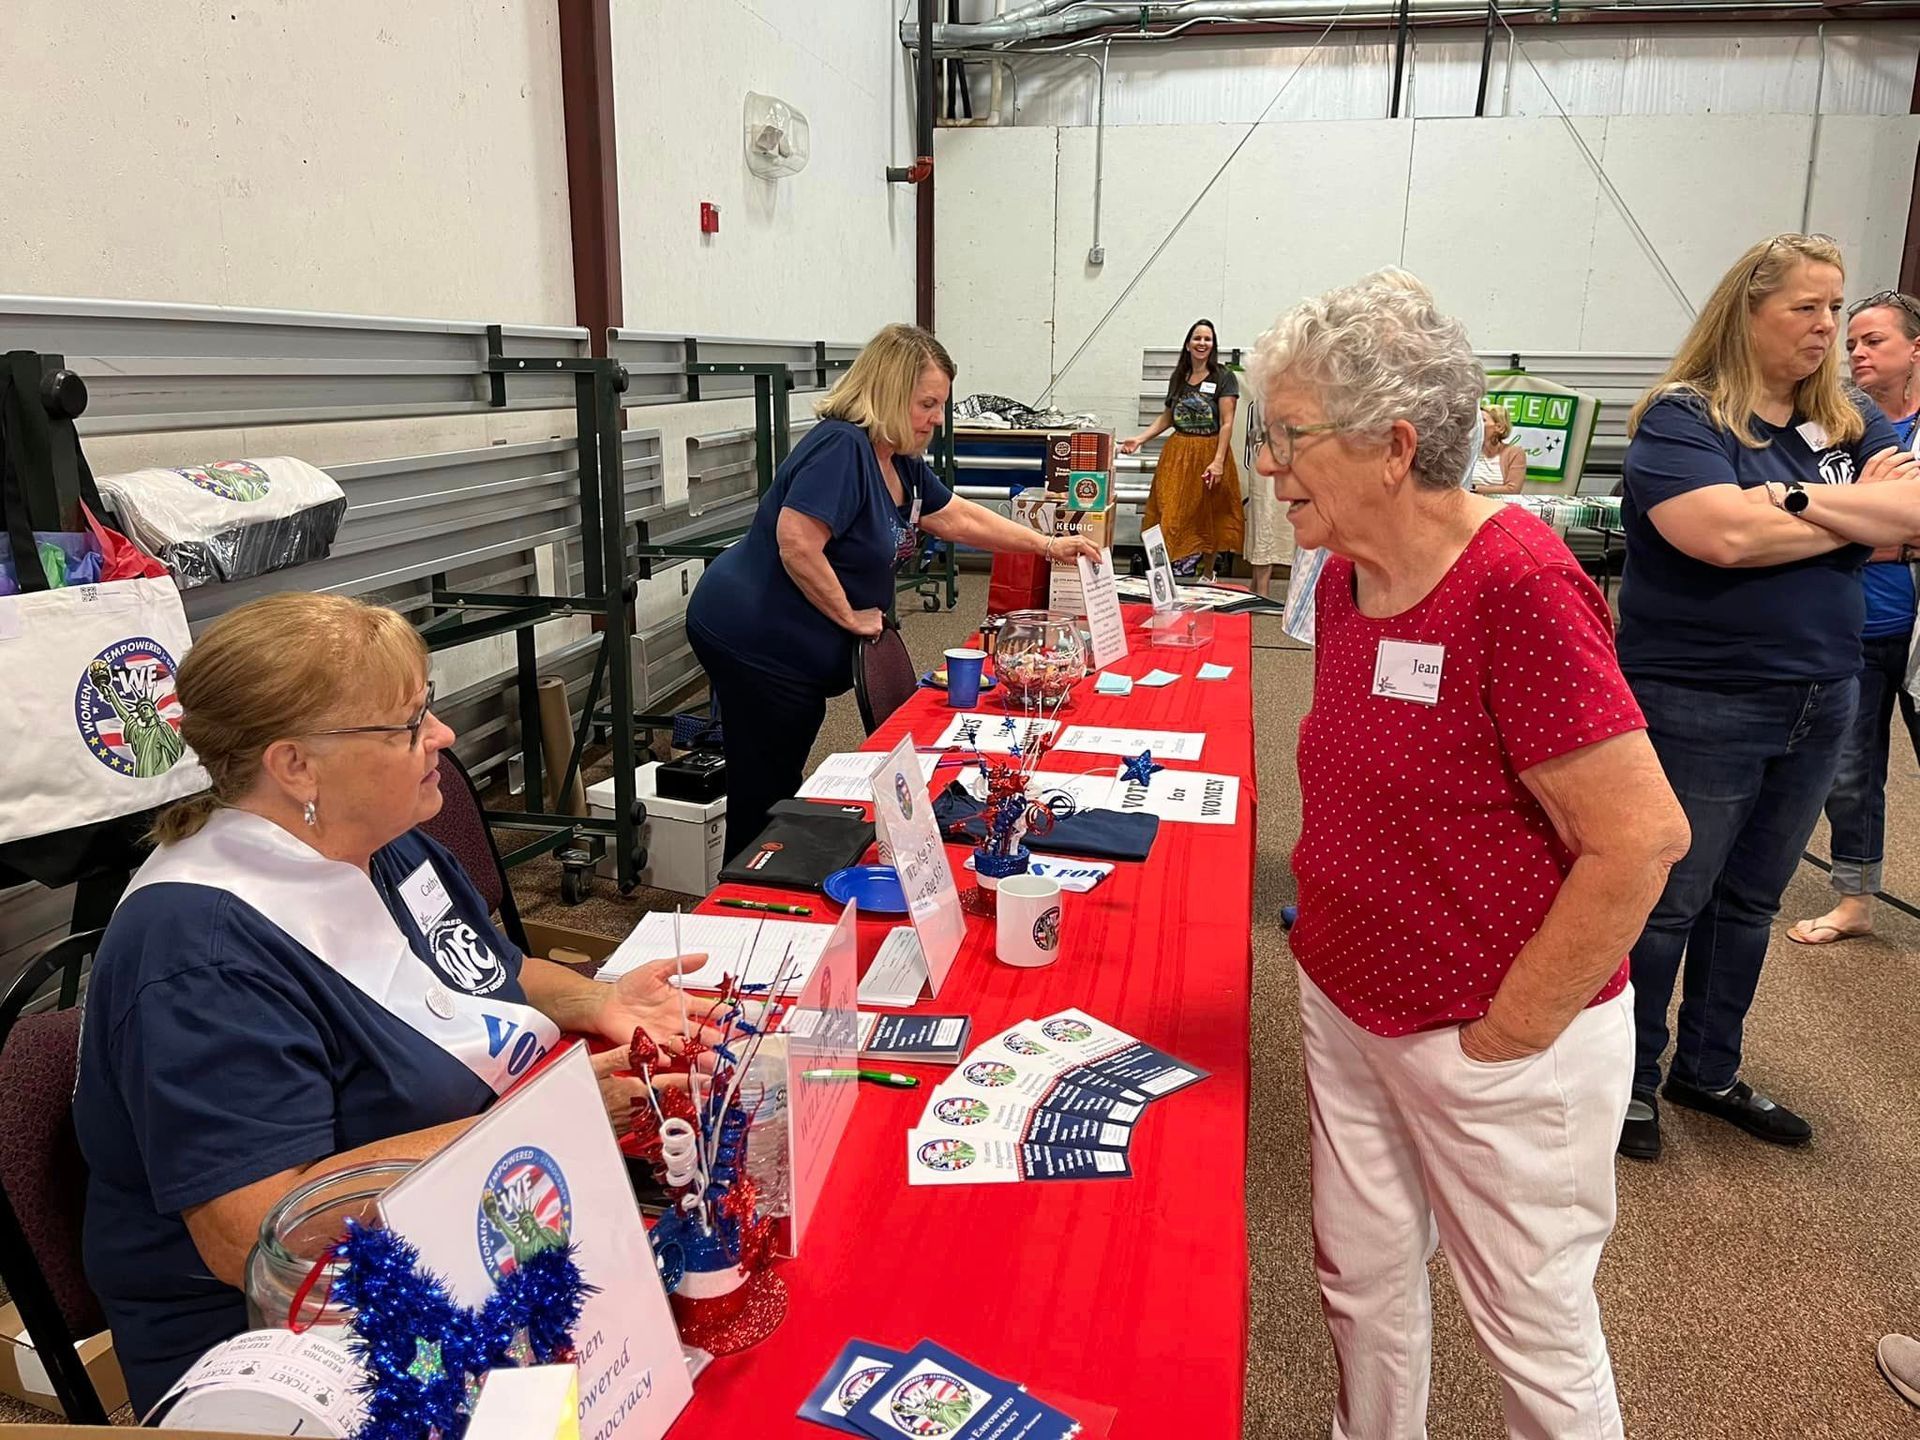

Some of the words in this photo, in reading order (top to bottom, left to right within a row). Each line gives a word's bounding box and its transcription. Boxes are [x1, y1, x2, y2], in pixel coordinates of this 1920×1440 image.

[1056, 522, 1094, 531] KEURIG
[1410, 659, 1439, 675] Jean
[81, 684, 92, 734] WOMEN
[104, 641, 162, 663] EMPOWERED
[118, 665, 158, 694] WE
[1166, 788, 1186, 802] for
[1200, 779, 1224, 816] WOMEN
[420, 876, 442, 897] Cathy
[436, 924, 495, 989] WE
[480, 1218, 494, 1270] WOMEN
[488, 1150, 534, 1190] EMPOWERED
[303, 1350, 322, 1361] THIS
[310, 1344, 346, 1364] COUPON
[322, 1359, 343, 1374] KEEP
[269, 1372, 310, 1394] TICKET
